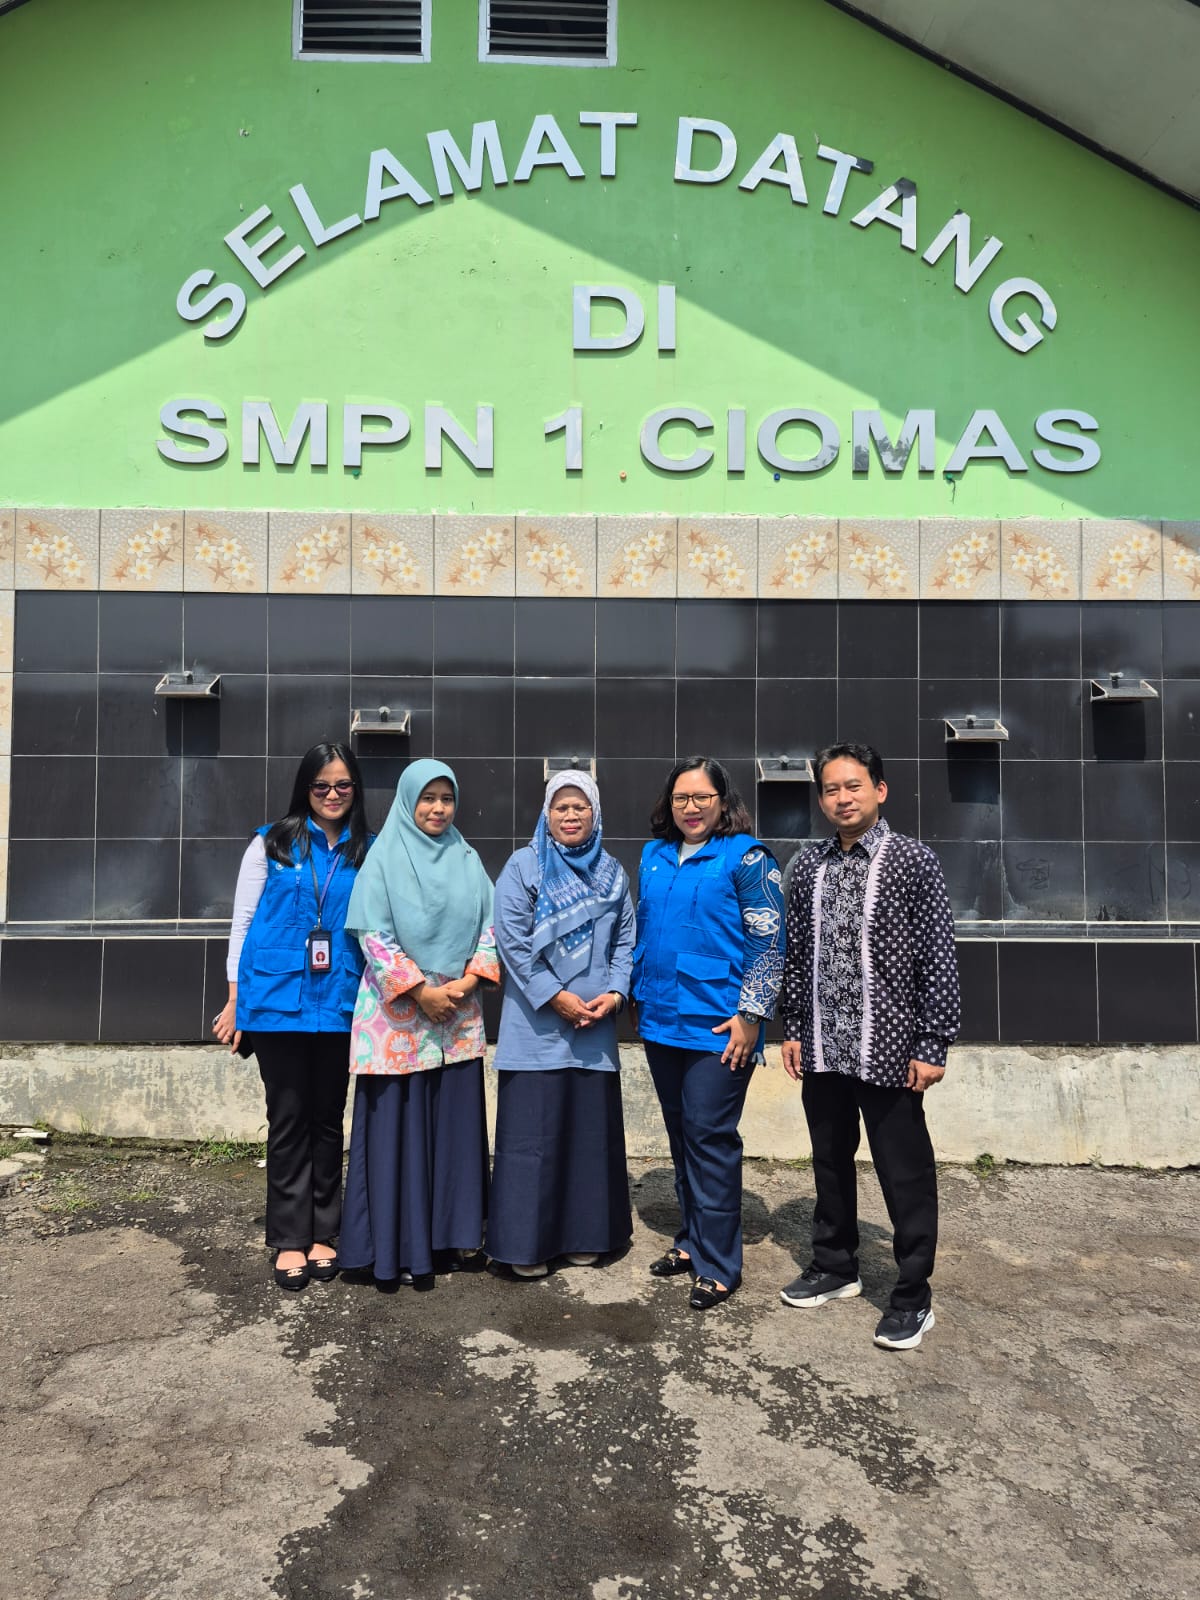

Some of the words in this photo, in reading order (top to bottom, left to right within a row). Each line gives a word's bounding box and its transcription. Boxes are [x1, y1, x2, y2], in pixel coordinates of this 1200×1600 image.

[176, 111, 638, 340] SELAMAT
[674, 116, 1058, 354] DATANG
[573, 284, 676, 351] DI
[156, 399, 494, 470] SMPN
[544, 406, 583, 471] 1
[640, 408, 1101, 474] CIOMAS
